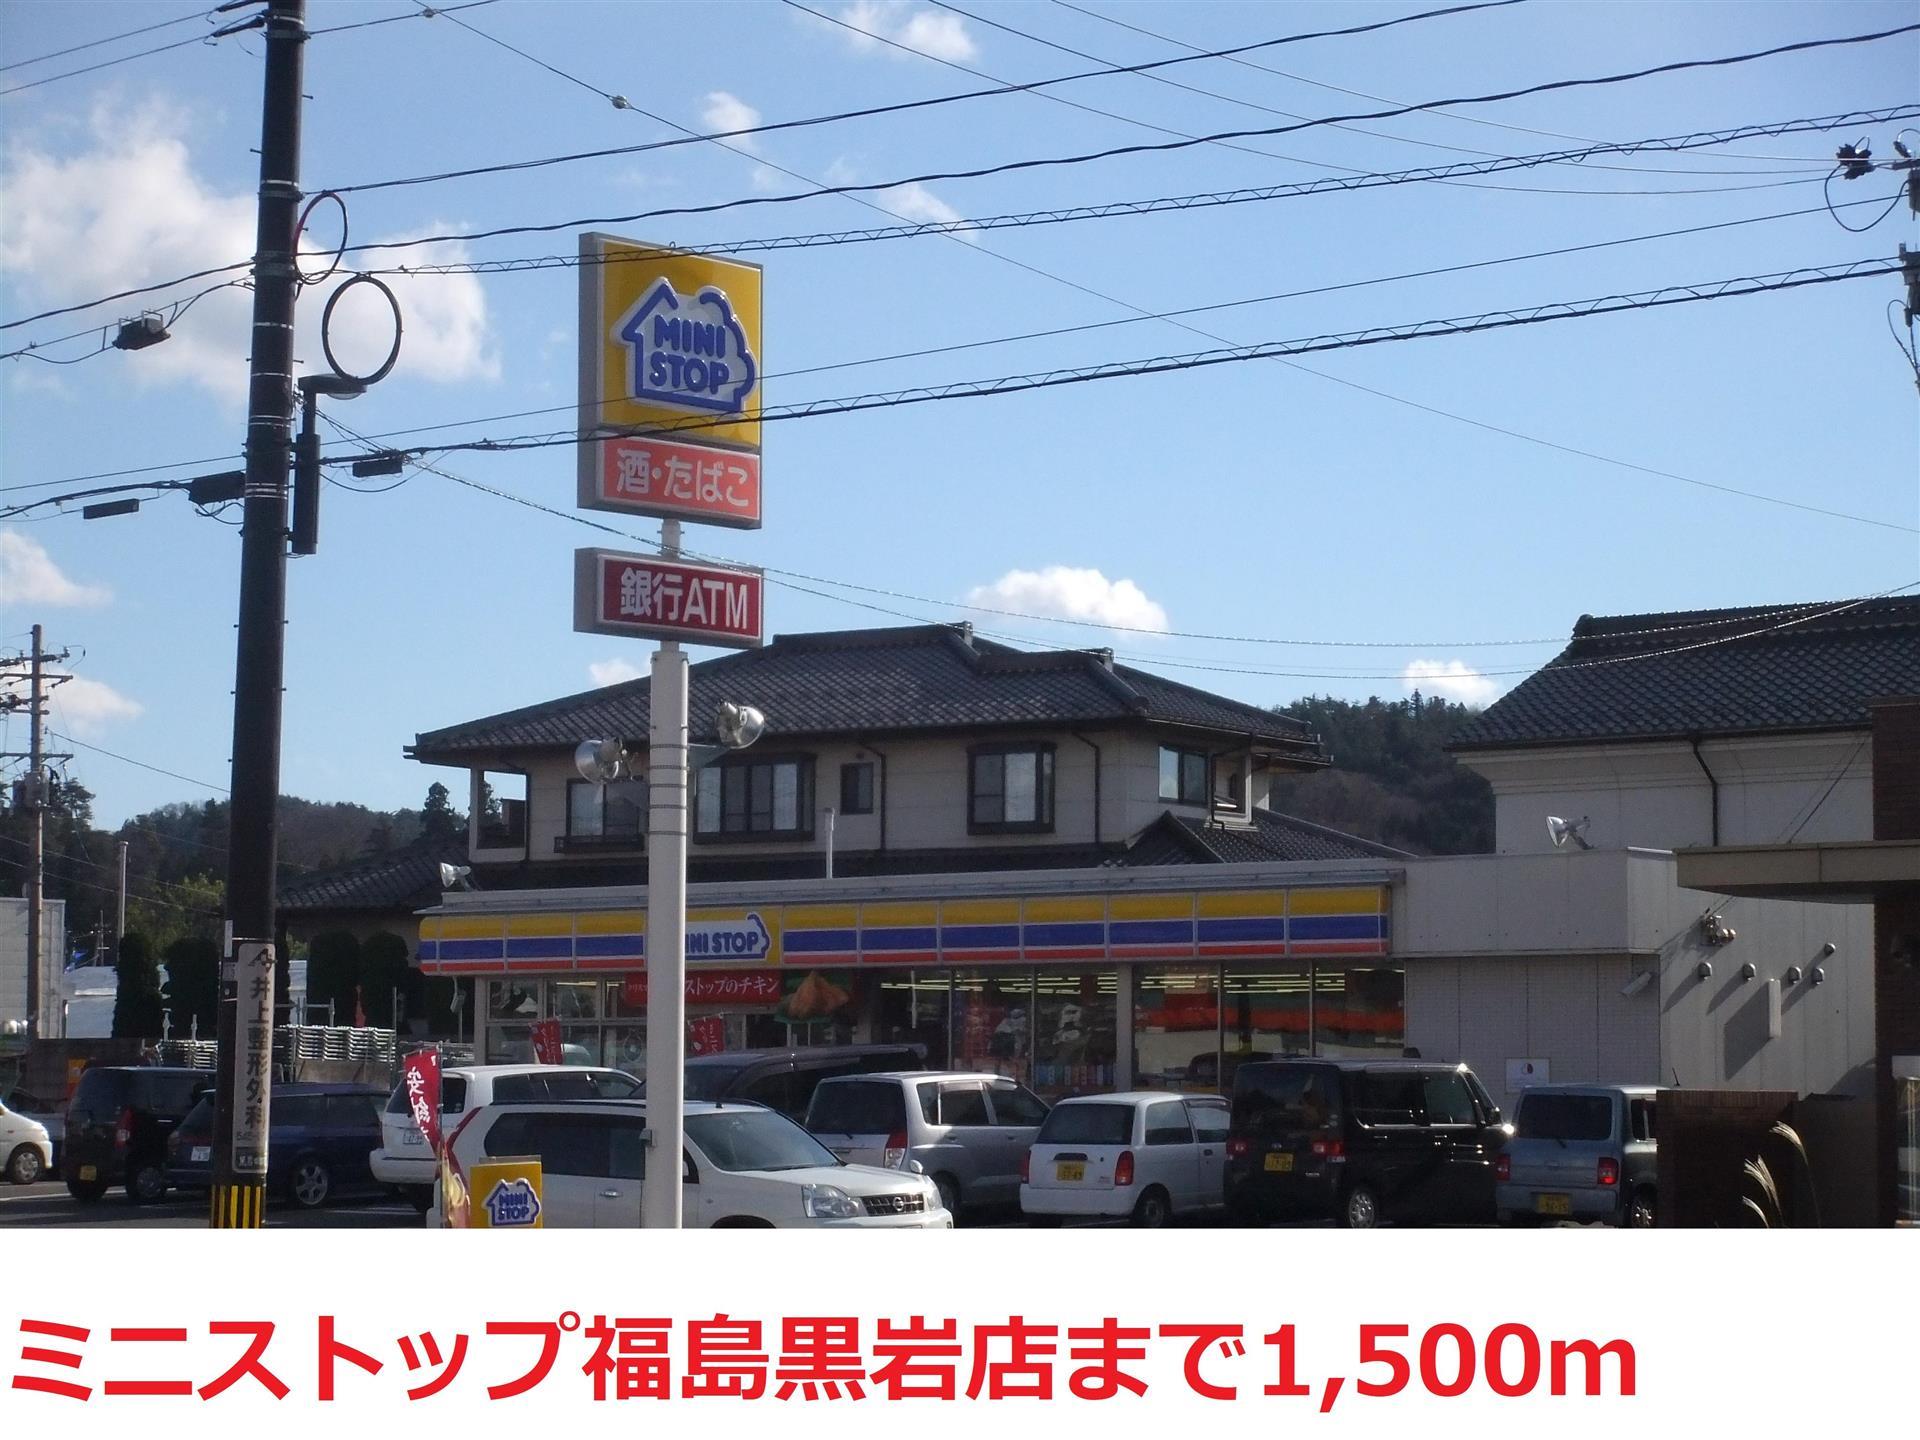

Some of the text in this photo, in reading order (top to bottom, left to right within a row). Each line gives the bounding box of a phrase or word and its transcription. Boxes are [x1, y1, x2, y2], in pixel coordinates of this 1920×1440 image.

[654, 314, 726, 359] MINI
[649, 351, 729, 395] STOP
[617, 448, 749, 507] 酒・たばこ
[621, 566, 748, 630] 銀行ATM
[711, 931, 759, 953] STOP
[497, 1206, 530, 1220] STOP
